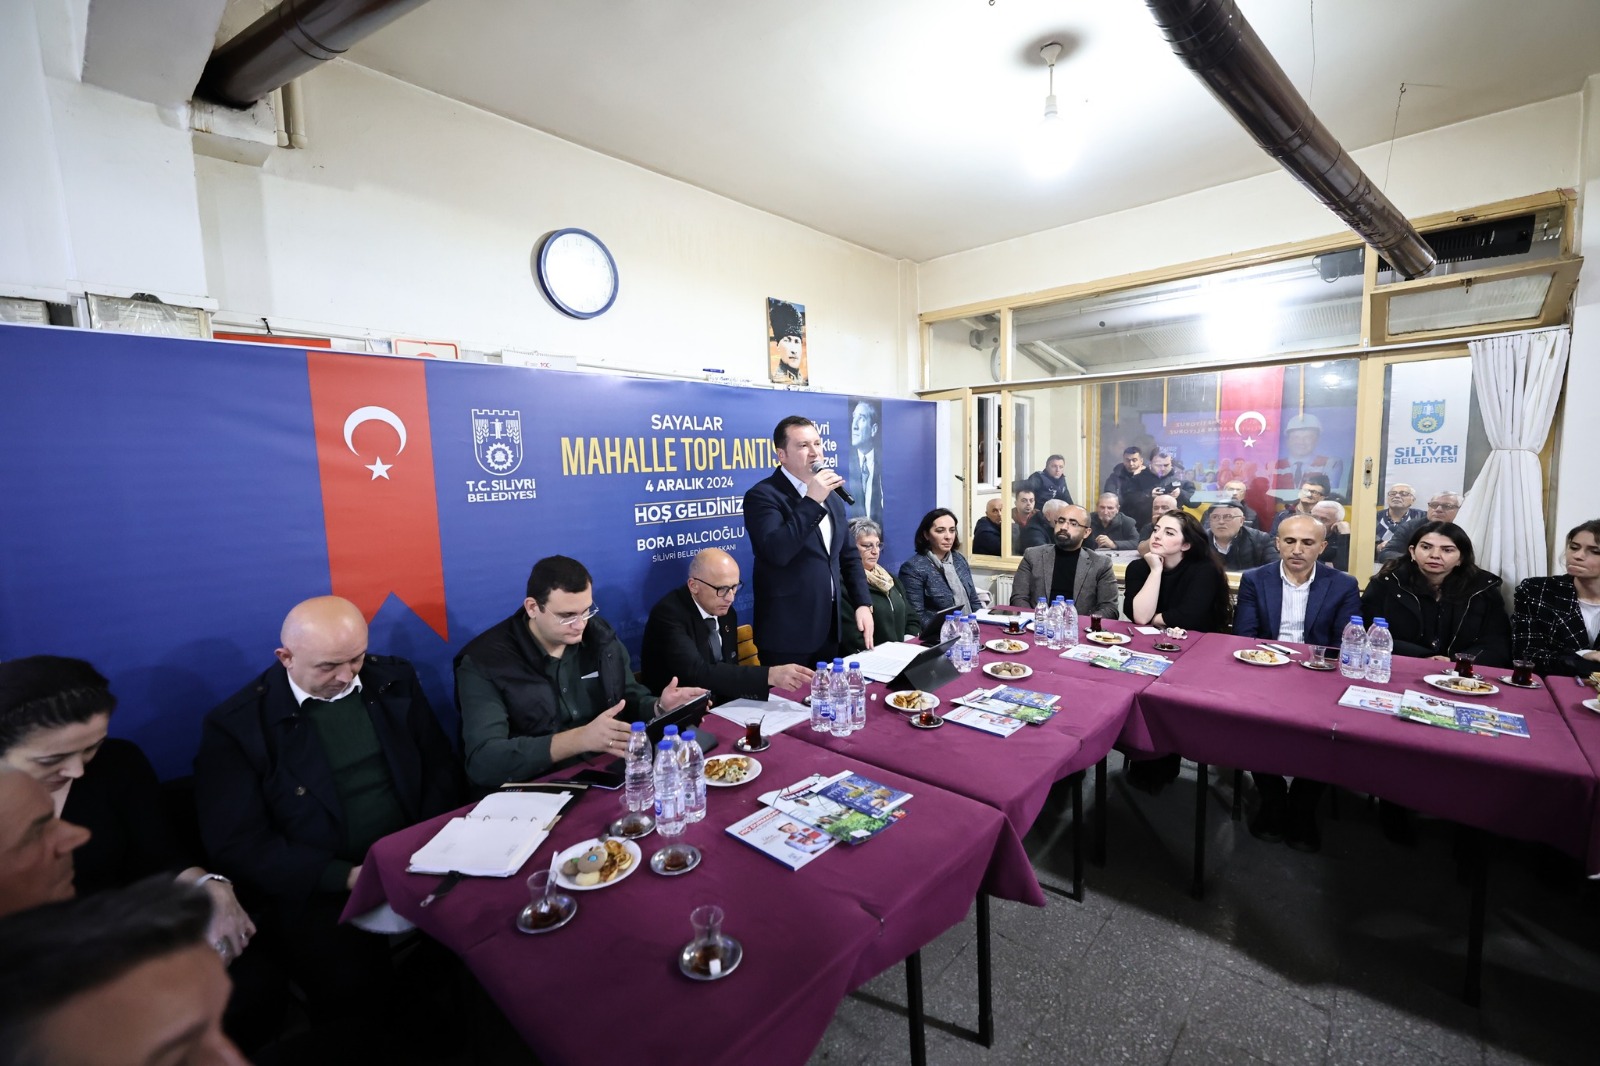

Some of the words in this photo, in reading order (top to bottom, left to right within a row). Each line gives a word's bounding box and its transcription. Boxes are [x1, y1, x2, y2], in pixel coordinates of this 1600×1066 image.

[651, 414, 723, 431] SAYALAR
[561, 437, 678, 476] MAHALLE
[466, 480, 490, 492] T.C.
[645, 480, 654, 492] 4
[657, 478, 704, 492] ARALIK
[706, 476, 734, 489] 2024
[635, 504, 672, 523] HOŞ
[675, 496, 744, 519] GELDİNİZ
[637, 536, 674, 551] BORA
[677, 526, 745, 546] BALCIOĞLU
[677, 548, 708, 558] BELEDİ
